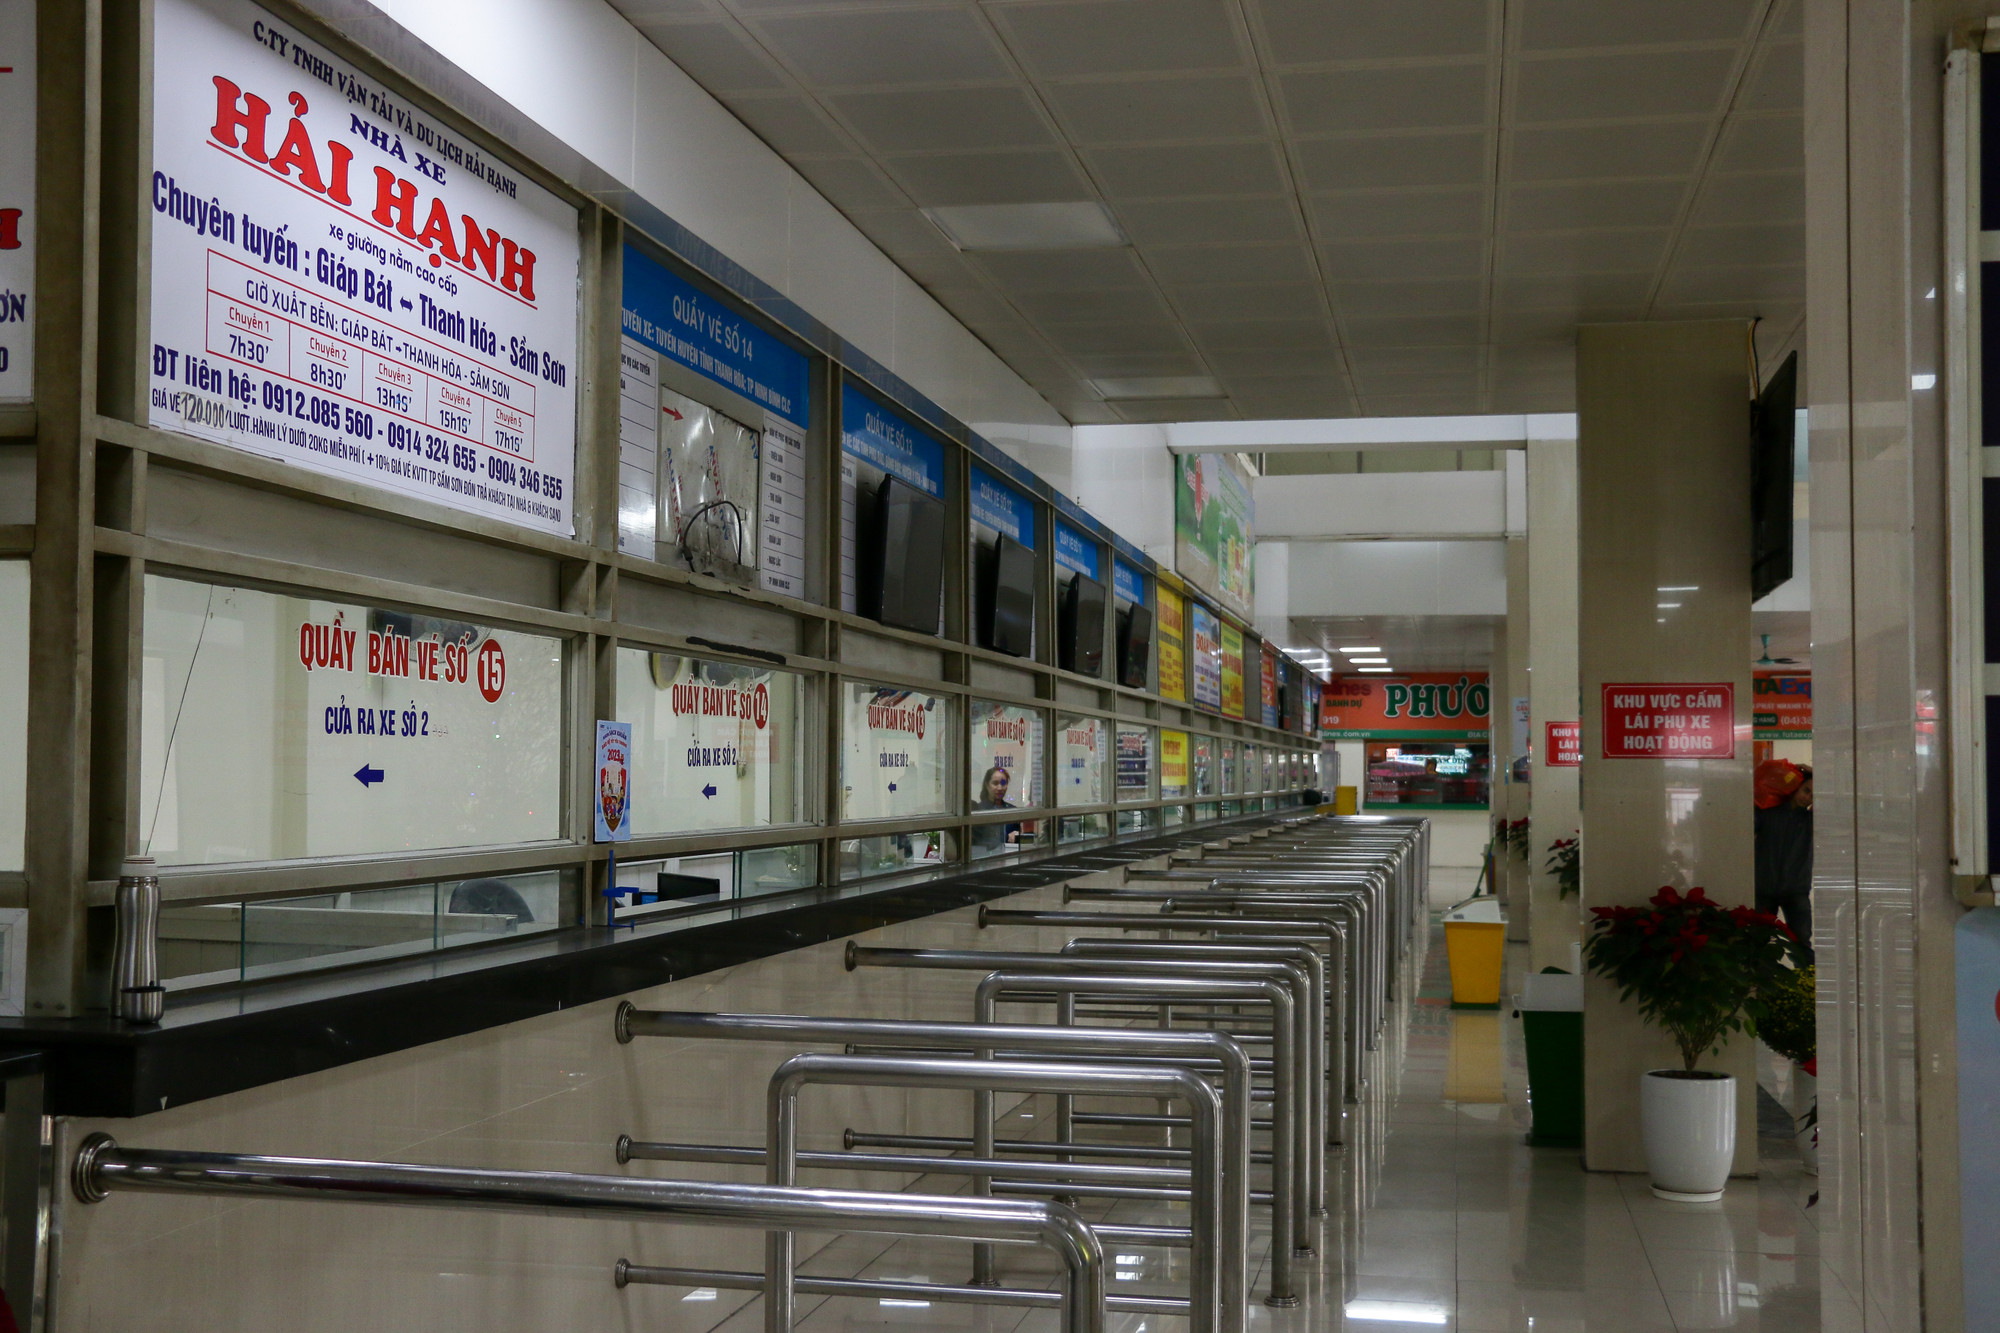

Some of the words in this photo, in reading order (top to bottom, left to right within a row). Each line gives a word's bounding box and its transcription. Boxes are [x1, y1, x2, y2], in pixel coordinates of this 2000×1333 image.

[254, 21, 288, 57] C.TY
[292, 44, 333, 86] TNHH
[338, 75, 367, 106] VẬN
[371, 92, 393, 122] TẢI
[397, 109, 413, 135] VÀ
[417, 122, 434, 147] DU
[437, 135, 462, 165] LỊCH
[465, 152, 485, 179] HẢI
[488, 167, 516, 199] HẠNH
[350, 113, 407, 164] NHÀ
[414, 152, 446, 186] XE
[210, 75, 353, 206] HẢI
[371, 165, 537, 301] HẠNH
[153, 170, 234, 244] Chuyên
[242, 213, 298, 272] tuyến
[316, 247, 358, 299] Giáp
[364, 268, 392, 313] Bát
[419, 293, 465, 344] Thanh
[470, 316, 496, 357] Hóa
[510, 336, 538, 376] Sầm
[542, 351, 566, 387] Sơn
[329, 223, 343, 240] xe
[347, 232, 386, 265] giường
[390, 249, 413, 275] nằm
[416, 265, 436, 286] cao
[438, 274, 457, 297] cấp
[229, 307, 263, 331] Chuyến
[265, 320, 269, 333] 1
[246, 280, 268, 304] GIỜ
[272, 289, 306, 319] XUẤT
[310, 302, 338, 332] BẾN:
[341, 315, 368, 345] GIÁP
[371, 330, 393, 354] BÁT
[403, 342, 438, 372] THANH
[442, 358, 462, 381] HÓA
[491, 381, 510, 400] SƠN
[708, 315, 722, 344] VÉ
[725, 323, 739, 354] SỐ
[742, 337, 752, 362] 14
[310, 337, 340, 359] Chuyến
[342, 349, 347, 361] 2
[378, 363, 406, 383] Chuyến
[407, 373, 412, 385] 3
[441, 387, 465, 406] Chuyến
[465, 396, 471, 407] 4
[496, 408, 517, 425] Chuyến
[518, 417, 522, 427] 5
[152, 388, 167, 410] GIÁ
[277, 422, 288, 442] LÝ
[289, 427, 307, 448] DƯỚI
[308, 433, 328, 454] 20KG
[349, 445, 361, 463] PHÍ
[391, 458, 402, 475] GIÁ
[402, 461, 411, 478] VÉ
[428, 469, 436, 485] TP
[153, 344, 178, 381] ĐT
[185, 354, 222, 395] liên
[228, 368, 257, 409] hệ:
[263, 381, 340, 430] 0912.085
[345, 407, 373, 440] 560
[387, 421, 422, 456] 0914
[425, 434, 449, 465] 324
[453, 444, 476, 473] 655
[488, 456, 517, 486] 0904
[519, 466, 540, 493] 346
[542, 474, 562, 500] 555
[300, 611, 357, 671] QUẦY
[368, 625, 410, 677] BÁN
[417, 633, 439, 681] VÉ
[445, 632, 469, 683] SỐ
[481, 650, 502, 691] 15
[325, 695, 352, 734] CỬA
[358, 708, 375, 735] RA
[379, 709, 396, 736] XE
[401, 700, 417, 736] SỐ
[421, 711, 429, 736] 2
[703, 681, 723, 716] BÁN
[726, 683, 737, 716] VÉ
[740, 684, 752, 720] SỐ
[755, 691, 767, 722] 14
[1614, 694, 1645, 708] KHU
[1650, 693, 1681, 711] VỰC
[1686, 689, 1722, 708] CẤM
[1552, 728, 1571, 737] KHU
[1624, 735, 1664, 752] HOẠT
[1668, 733, 1712, 752] ĐỘNG
[1625, 712, 1649, 728] LÁI
[1654, 715, 1686, 732] PHỤ
[1690, 715, 1710, 728] XE
[688, 740, 700, 766] CỬA
[702, 748, 711, 766] RA
[713, 748, 721, 766] XE
[722, 741, 731, 766] SỐ
[732, 748, 736, 765] 2
[1559, 739, 1573, 749] LÁI
